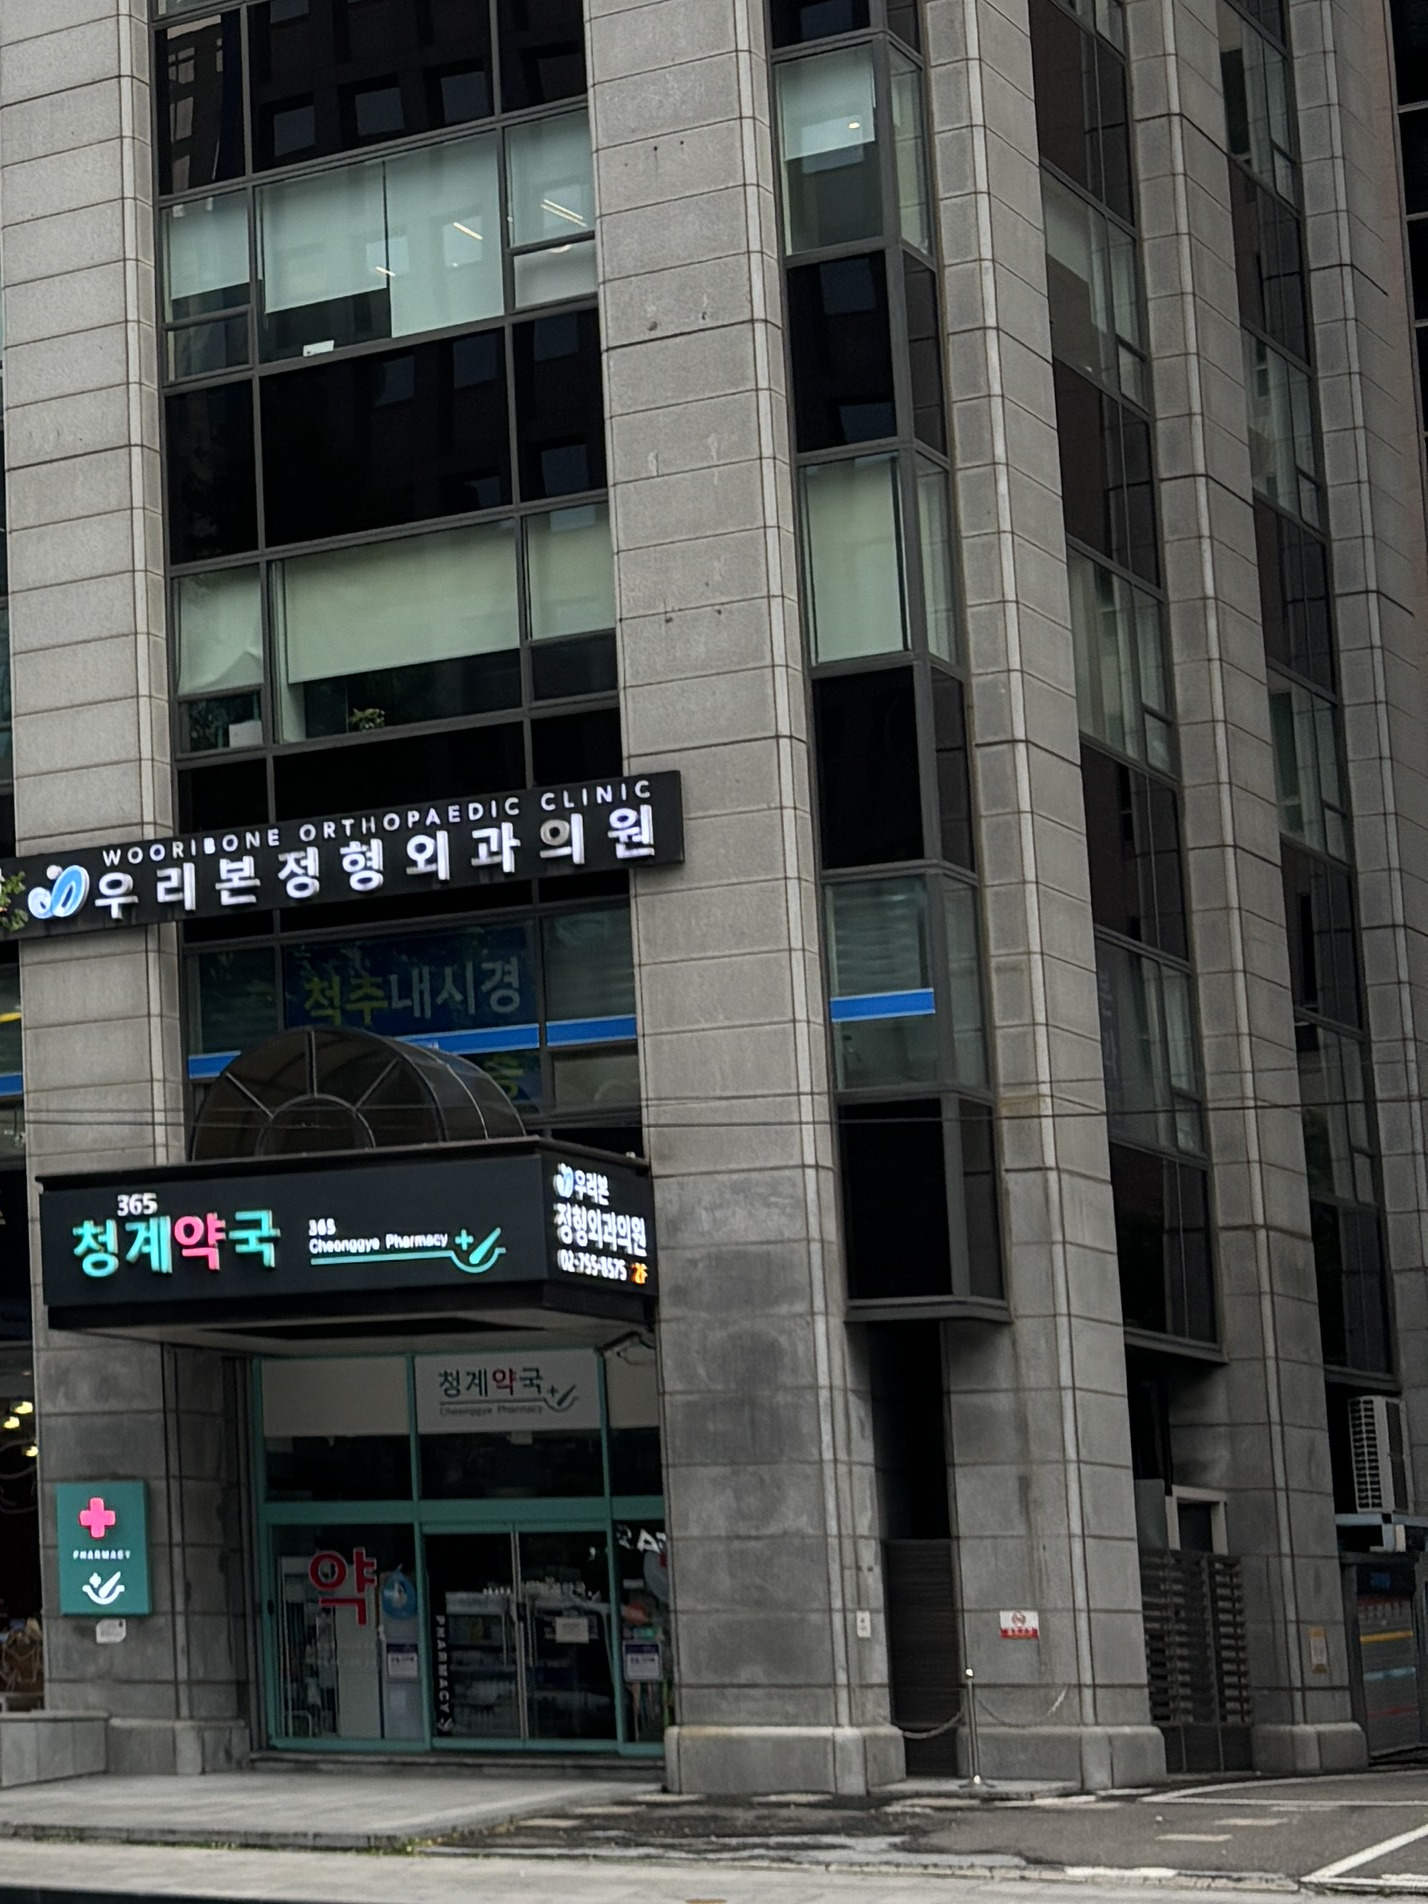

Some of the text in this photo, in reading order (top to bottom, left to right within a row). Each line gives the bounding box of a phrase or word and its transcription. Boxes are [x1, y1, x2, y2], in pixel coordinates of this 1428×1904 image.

[103, 780, 652, 867] WOORIBONE ORTHOPAEDIC CLINIC
[94, 803, 656, 919] 우리본정형외과의원
[116, 1192, 158, 1217] 365
[574, 1169, 610, 1205] 우리본
[72, 1209, 281, 1278] 청계약국
[308, 1233, 449, 1254] Cheonggye Pharmacy
[554, 1202, 647, 1257] 정형외과의원
[438, 1367, 543, 1397] 청계약국
[72, 1549, 131, 1561] PHARMACY
[309, 1546, 378, 1628] 약
[435, 1615, 450, 1714] PHARMACY
